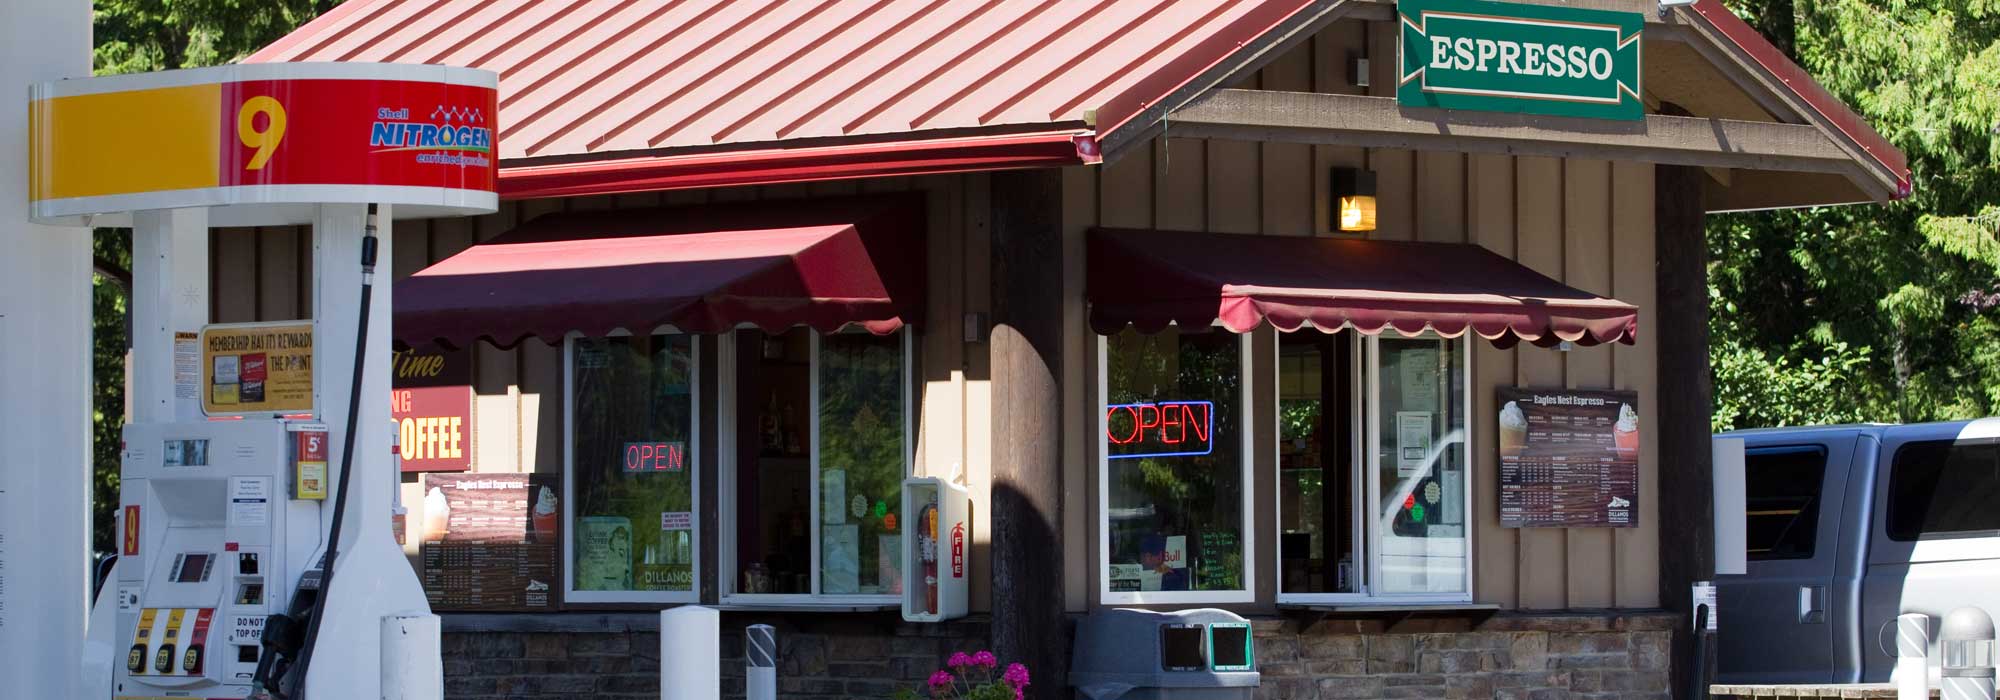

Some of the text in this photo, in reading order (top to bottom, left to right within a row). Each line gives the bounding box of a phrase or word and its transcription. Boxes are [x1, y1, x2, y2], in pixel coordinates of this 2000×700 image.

[1429, 35, 1613, 80] ESPRESSO
[378, 107, 409, 119] Shell
[237, 95, 287, 170] 9
[369, 121, 491, 147] NITROGEN
[416, 151, 462, 165] enriched
[209, 335, 249, 352] MEMBERSHIP
[251, 335, 264, 350] HAS
[265, 334, 276, 350] ITS
[271, 355, 283, 371] THE
[1534, 395, 1604, 406] Eagles Nest Espresso
[1106, 404, 1209, 444] OPEN
[392, 416, 462, 461] OFFEE
[626, 444, 684, 469] OPEN
[127, 508, 136, 553] 9
[954, 536, 962, 574] FIRE
[1165, 549, 1181, 561] Bull
[645, 571, 692, 583] DILLANOS
[237, 617, 264, 627] DO NOT
[236, 629, 250, 637] TOP
[186, 655, 195, 665] 92
